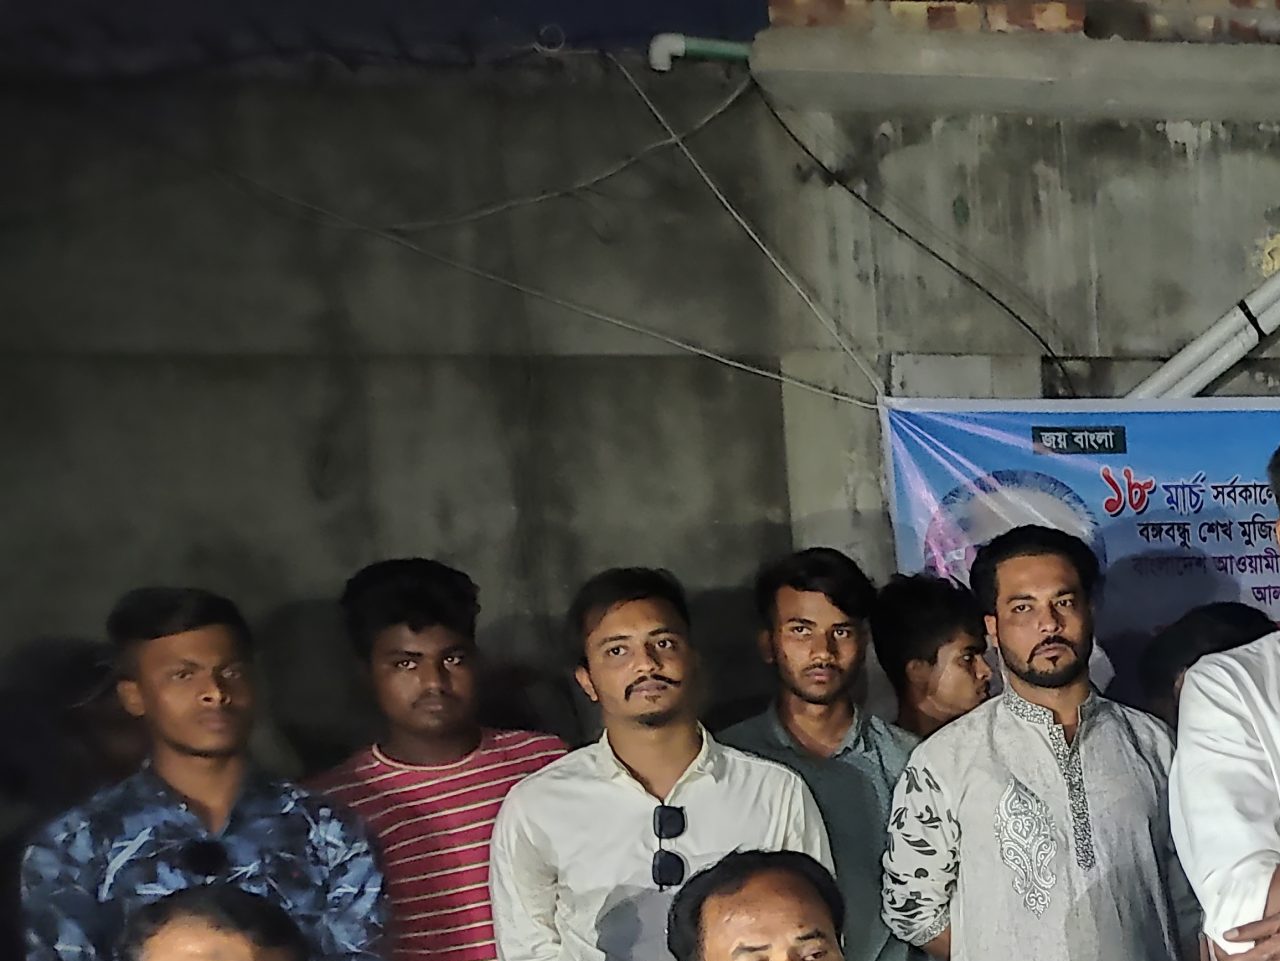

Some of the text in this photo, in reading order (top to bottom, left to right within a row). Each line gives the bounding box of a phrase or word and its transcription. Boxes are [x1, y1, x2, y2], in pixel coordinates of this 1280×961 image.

[1040, 430, 1115, 449] জয় বাংলা
[1101, 466, 1156, 516] ১৮
[1162, 472, 1206, 514] মার্চ
[1137, 522, 1191, 549] বঙ্গবন্ধু
[1199, 520, 1234, 543] শেখ
[1213, 547, 1280, 575] আওয়ামী
